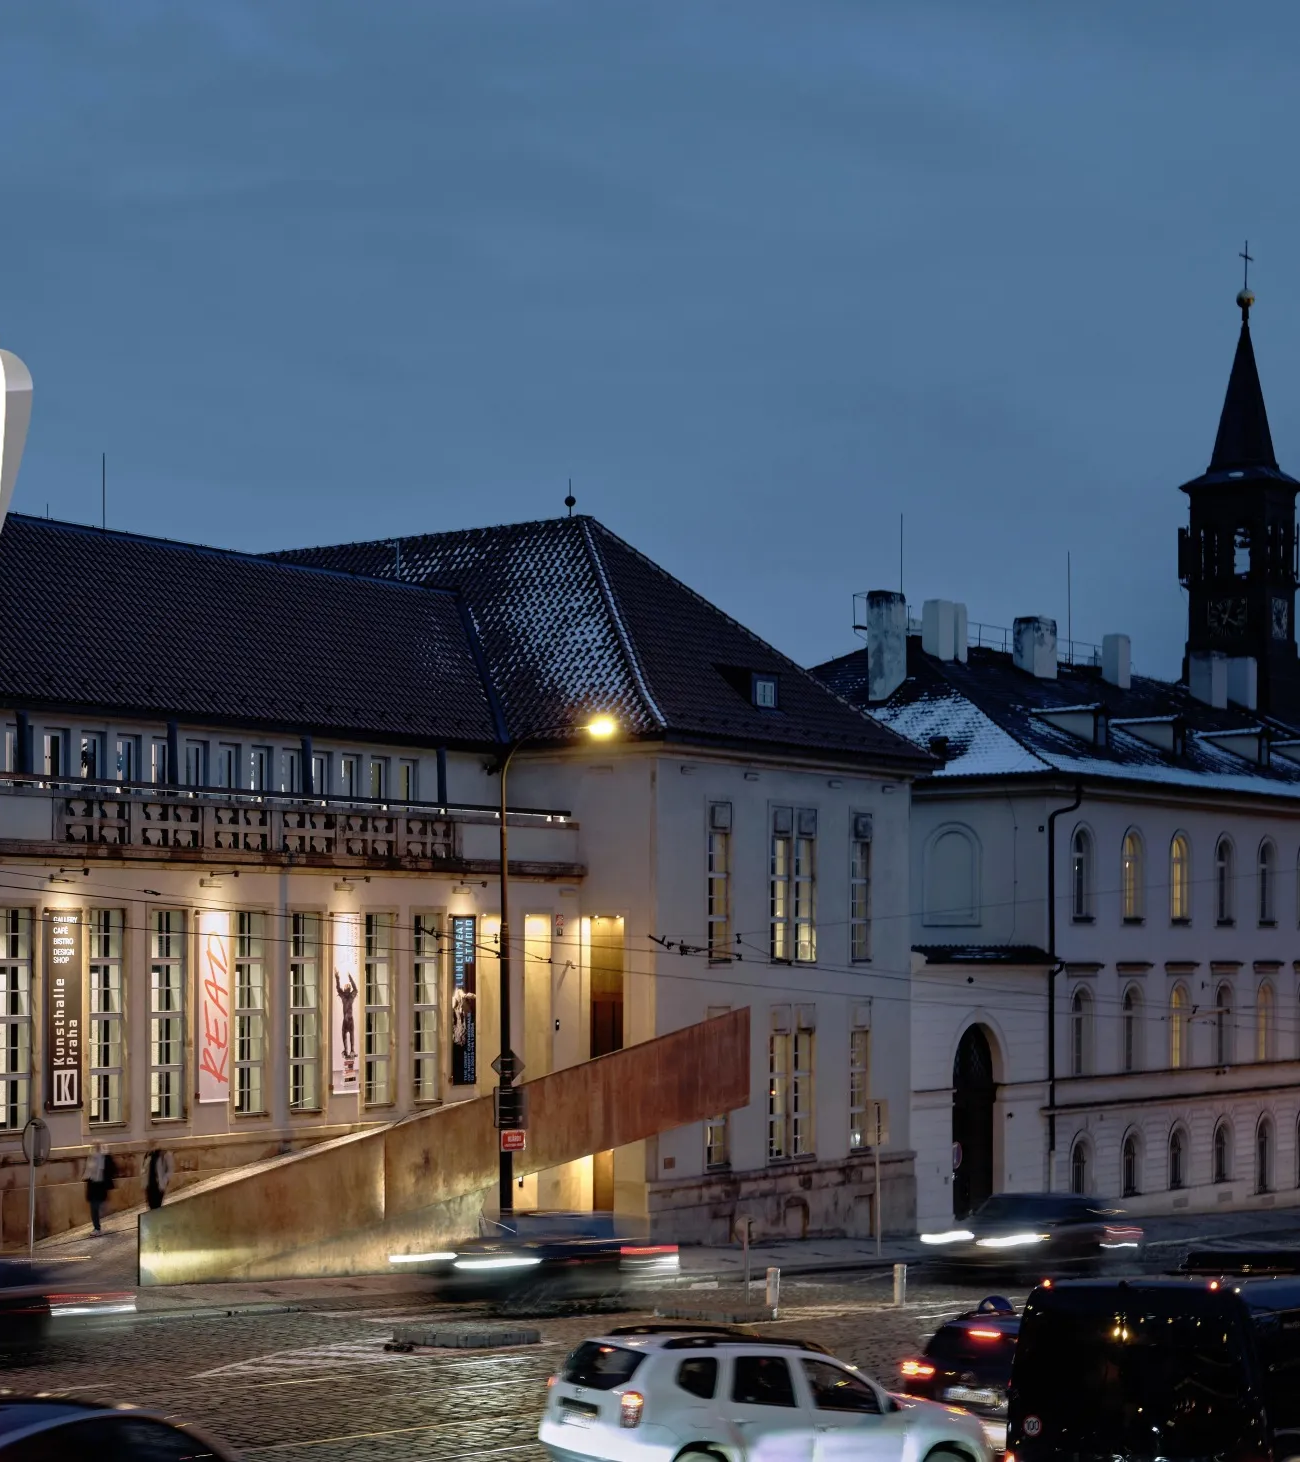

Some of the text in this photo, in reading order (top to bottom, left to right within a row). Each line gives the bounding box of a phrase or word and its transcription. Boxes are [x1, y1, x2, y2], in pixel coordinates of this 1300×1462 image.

[455, 920, 464, 986] LUNCHMEAT
[53, 978, 65, 1066] Kunsthalle
[66, 1020, 78, 1065] Praha
[200, 931, 228, 1083] READ
